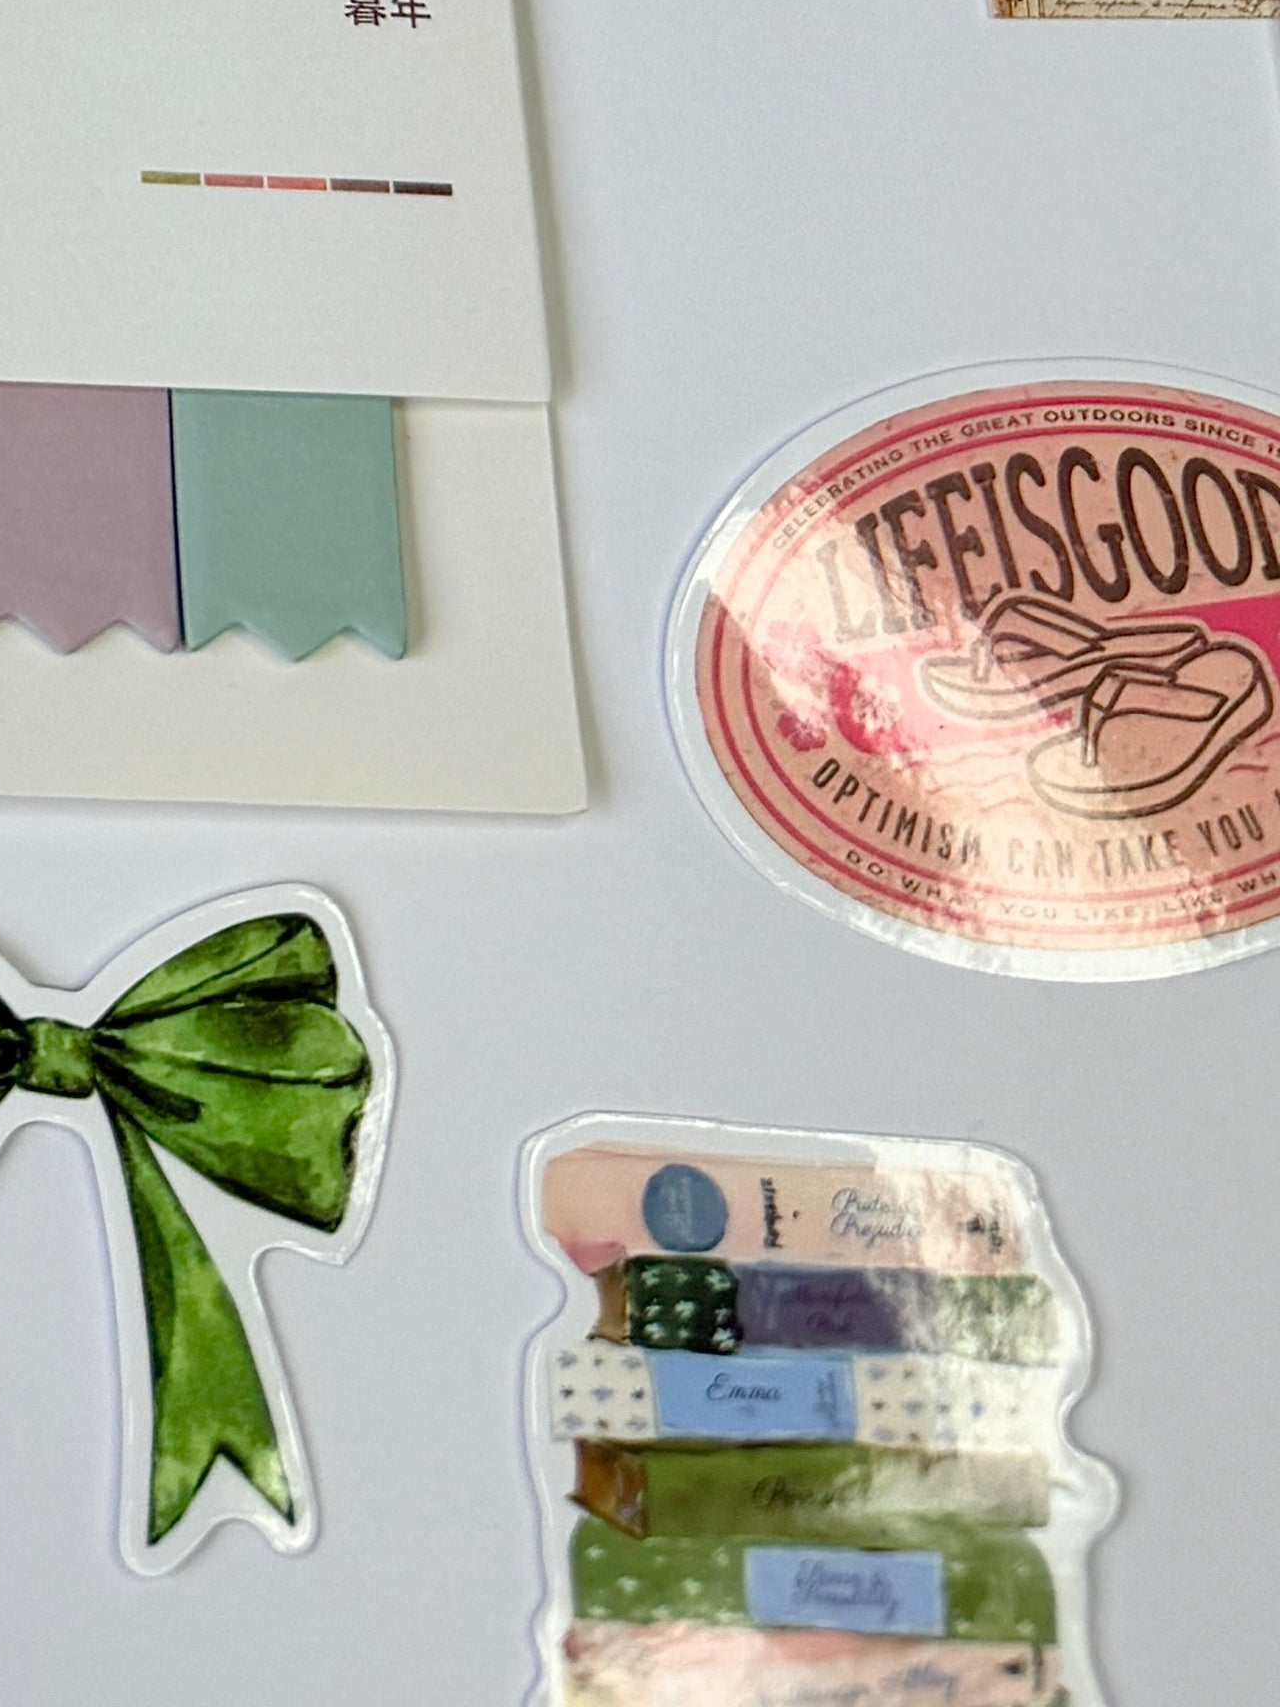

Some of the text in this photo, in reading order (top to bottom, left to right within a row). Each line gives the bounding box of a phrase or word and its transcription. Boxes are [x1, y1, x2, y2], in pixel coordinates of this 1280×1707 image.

[773, 448, 904, 550] CELEBRATING
[909, 430, 954, 453] THE
[960, 412, 1034, 437] GREAT
[1044, 407, 1175, 427] OUTDOORS
[1184, 418, 1256, 447] SINCE
[811, 757, 1264, 878] OPTIMISM CAN TAKE YOU
[846, 849, 883, 876] DO
[901, 874, 986, 907] WHAT
[1001, 903, 1057, 920] YOU
[1163, 891, 1224, 912] LIKE
[706, 1371, 782, 1402] Emma
